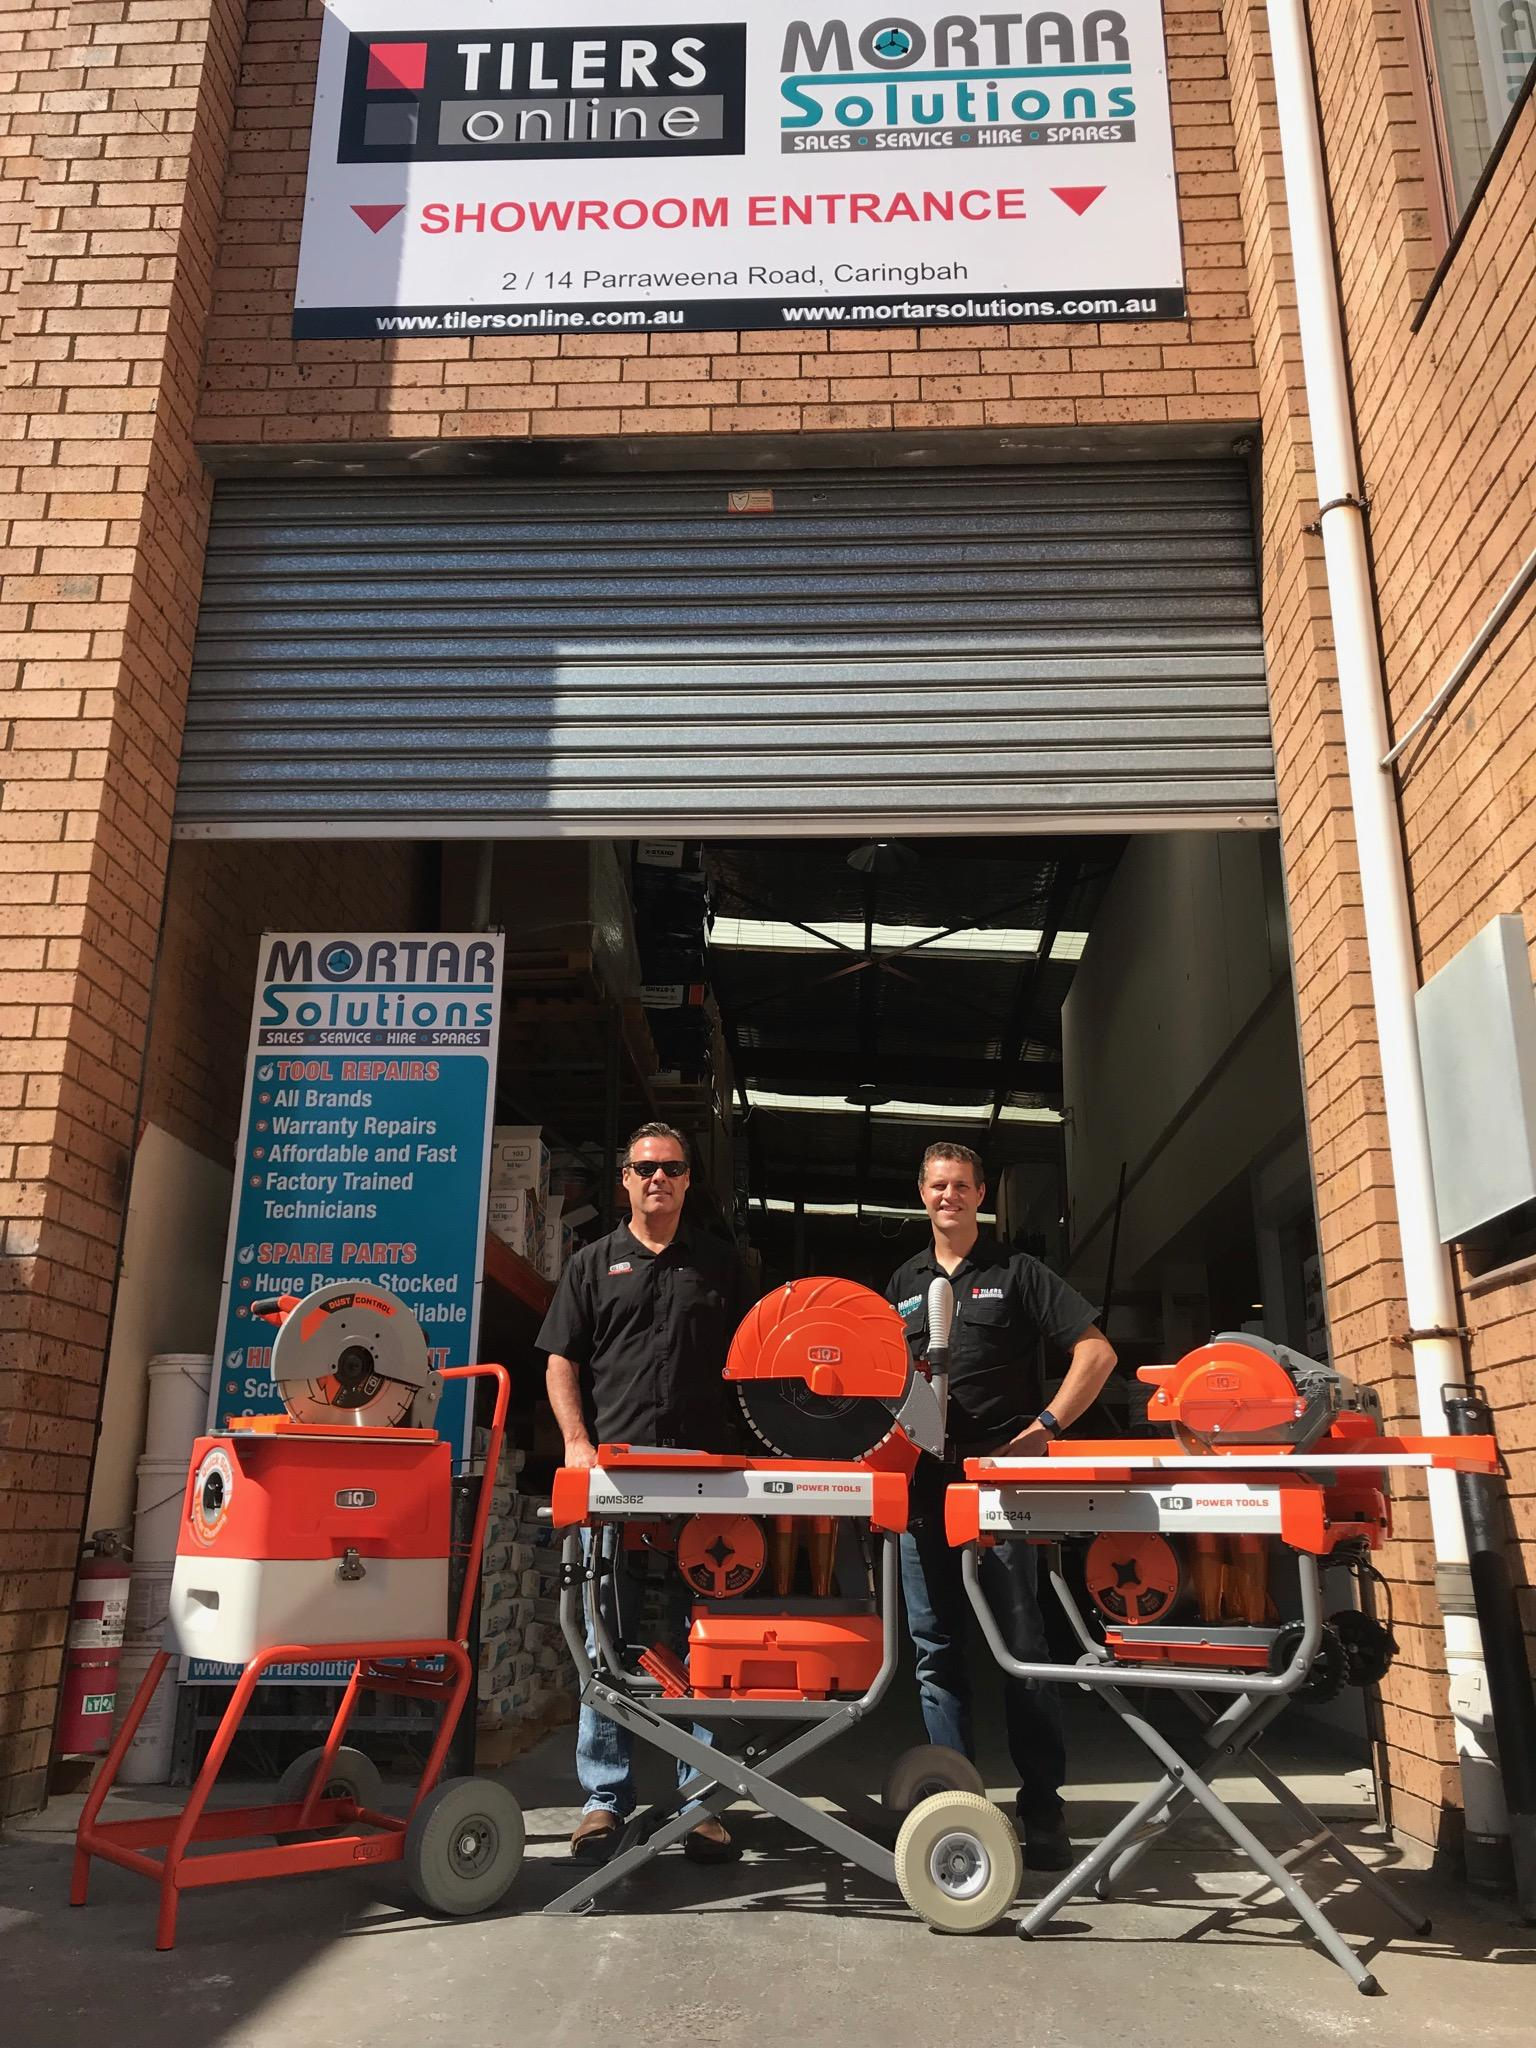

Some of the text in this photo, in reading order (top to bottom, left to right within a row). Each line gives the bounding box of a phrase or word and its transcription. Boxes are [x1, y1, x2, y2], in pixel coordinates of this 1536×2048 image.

[780, 9, 1129, 73] MORTAR
[458, 37, 706, 91] TILERS
[780, 66, 1136, 128] Solutions
[464, 97, 700, 142] online
[793, 125, 1121, 151] SALES SERVICE HIRE SPARES
[420, 188, 1027, 234] SHOWROOM ENTRANCE
[502, 262, 969, 290] 2 / 14 Parraweena Road, Caringbah
[376, 309, 684, 331] www.tilersonline.com.au
[782, 297, 1157, 322] www.mortarsolutions.com.au
[264, 940, 495, 983] MORTAR
[260, 985, 493, 1027] Solutions
[266, 1032, 481, 1045] SALES SERVICE HIRE SPARES
[277, 1061, 440, 1081] TOOL REPAIRS
[273, 1089, 372, 1107] All Brands
[272, 1116, 436, 1138] Warranty Repairs
[268, 1144, 457, 1162] Affordable and Fast
[265, 1172, 413, 1194] Factory Trained
[263, 1200, 377, 1219] Technicians
[258, 1242, 417, 1264] SPARE PARTS
[255, 1273, 303, 1294] Huge
[378, 1273, 458, 1293] Stocked
[328, 1296, 392, 1315] DUST CONTROL
[413, 1303, 467, 1322] ilable
[347, 1490, 365, 1507] iQ
[772, 1482, 861, 1493] iQ POWER TOOLS
[595, 1495, 644, 1506] iQMS362
[1168, 1497, 1269, 1509] iQ POWER TOOLS
[985, 1510, 1032, 1522] iQTS244
